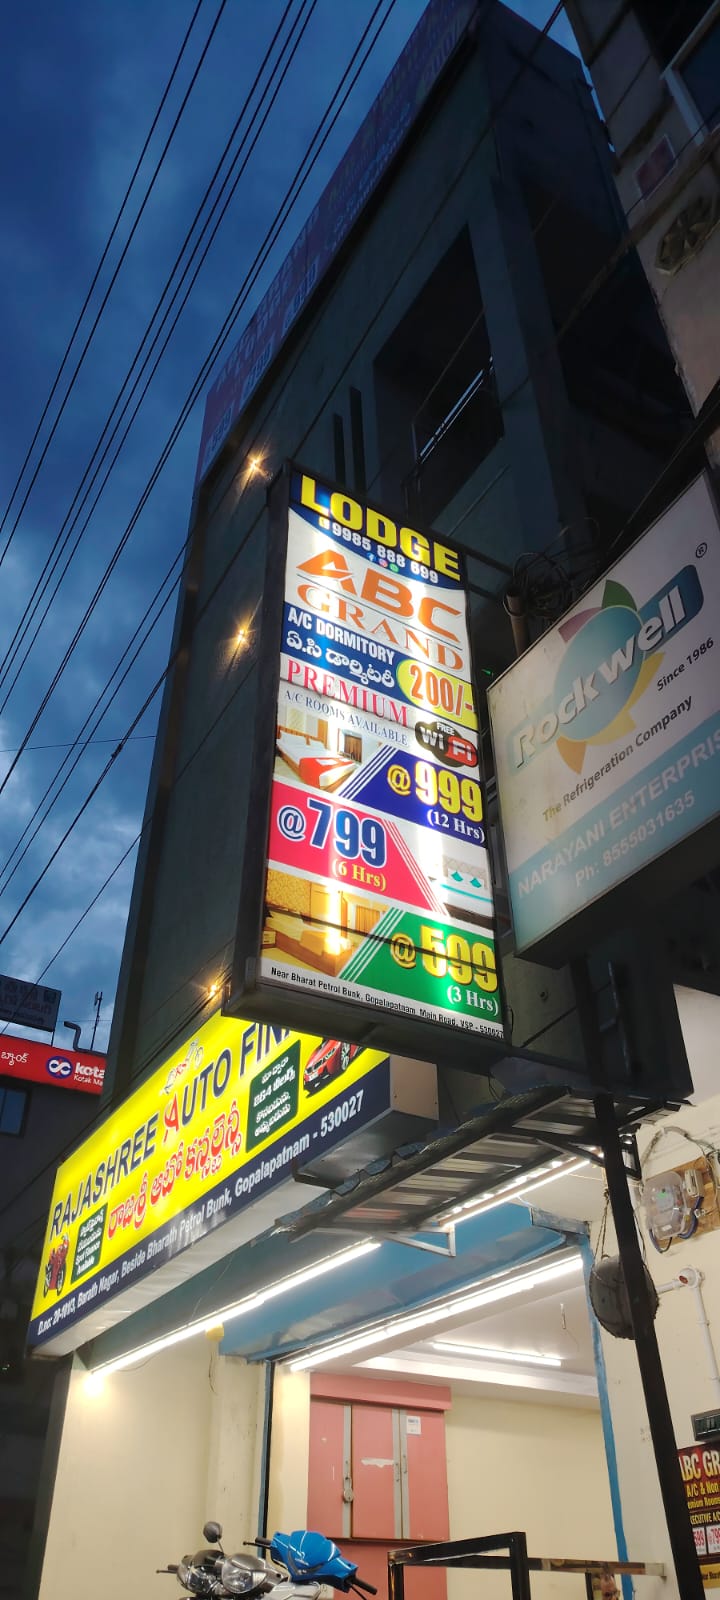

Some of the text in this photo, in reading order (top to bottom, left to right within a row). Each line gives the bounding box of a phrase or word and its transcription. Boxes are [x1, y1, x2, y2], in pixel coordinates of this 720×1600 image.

[301, 474, 461, 581] LODGE
[332, 523, 371, 551] 9985
[376, 545, 406, 568] 888
[296, 549, 462, 643] ABC
[297, 583, 464, 670] GRAND
[288, 607, 395, 666] A/C DORMITORY
[656, 637, 714, 692] Since 1986
[287, 659, 408, 728] PREMIUM
[410, 664, 473, 716] 200/-
[513, 584, 687, 769] Rockwell
[285, 690, 408, 746] A/C ROOMS AVAILABLE
[437, 722, 455, 736] FREE
[543, 696, 692, 822] The Refrigeration Company
[426, 808, 485, 843] (12 Hrs)
[574, 790, 695, 888] Ph: 8555031635
[331, 857, 387, 892] (6 Hrs)
[517, 820, 605, 899] NARAYANI
[271, 966, 289, 979] Near
[291, 972, 316, 987] Bharat
[318, 980, 341, 994] Petrol
[419, 1008, 437, 1021] Main
[447, 985, 499, 1017] (3 Hrs)
[49, 1112, 159, 1242] RAJASHREE
[163, 1048, 232, 1143] AUTO
[121, 1249, 146, 1278] Beside
[179, 1204, 205, 1237] Petrol
[206, 1186, 232, 1218] Bunk,
[234, 1133, 310, 1198] Gopalapatnam
[321, 1088, 364, 1138] 530027
